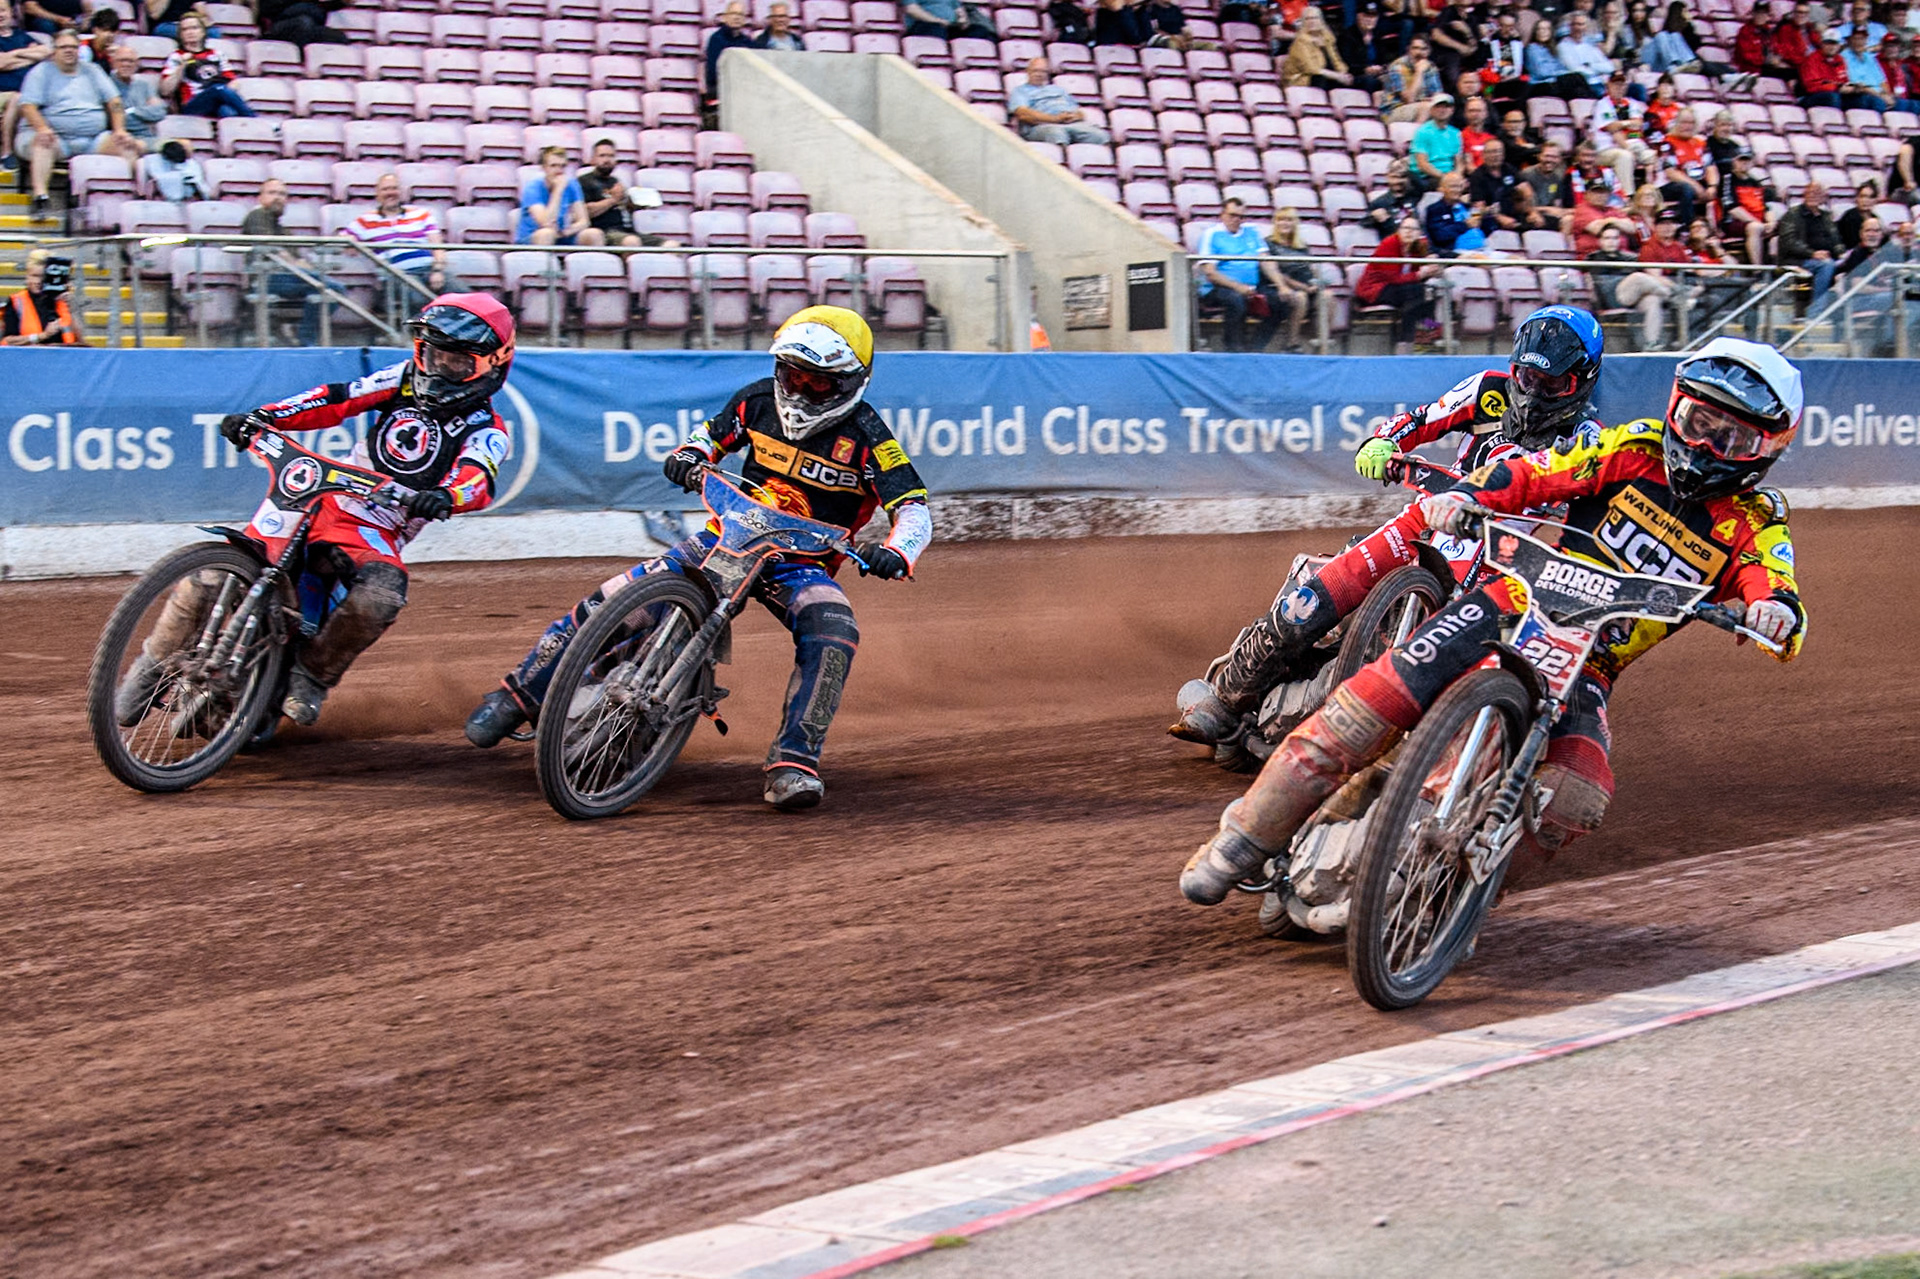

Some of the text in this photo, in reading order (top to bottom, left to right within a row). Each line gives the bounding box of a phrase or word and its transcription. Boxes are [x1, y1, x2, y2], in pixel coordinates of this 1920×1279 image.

[9, 412, 174, 472] Class
[879, 405, 1026, 457] World
[1041, 405, 1168, 455] Class
[1181, 405, 1324, 455] Travel
[1803, 403, 1920, 447] Delive
[837, 439, 852, 459] 7
[801, 459, 858, 487] JCB
[1623, 491, 1713, 561] WATLING JCB
[1715, 518, 1739, 541] 4
[1538, 560, 1622, 602] BORGE
[1401, 603, 1484, 666] ignite
[1520, 638, 1574, 677] 22
